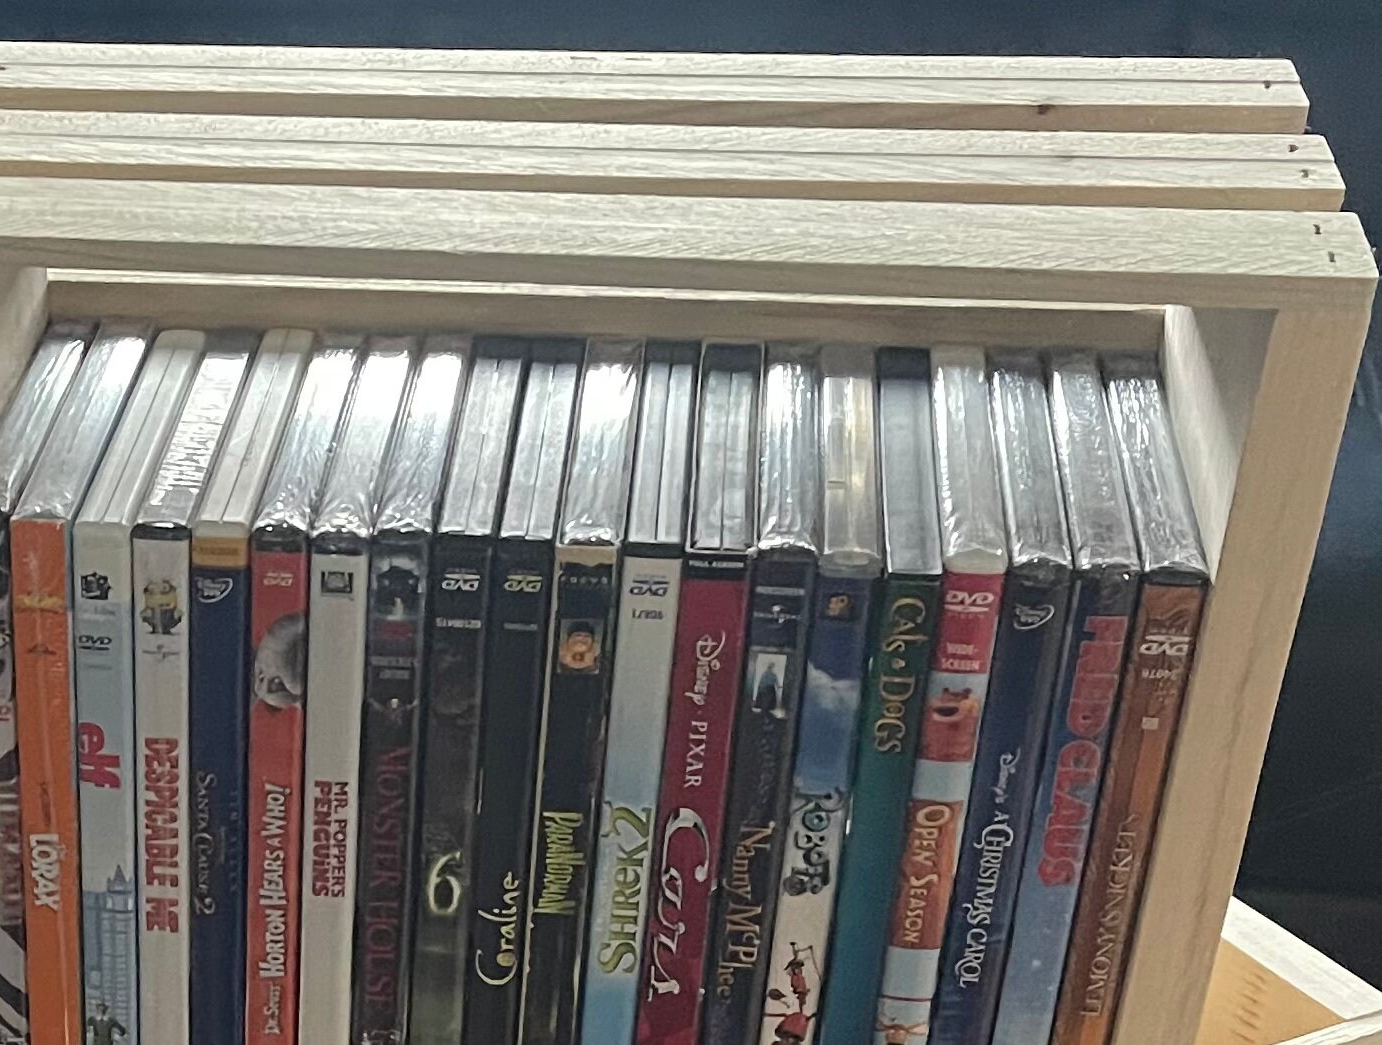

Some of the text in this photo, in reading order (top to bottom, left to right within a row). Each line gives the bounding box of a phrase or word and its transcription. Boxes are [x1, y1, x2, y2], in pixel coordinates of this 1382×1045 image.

[441, 577, 480, 592] DVD
[504, 579, 543, 593] DVD
[629, 584, 669, 598] DVD
[945, 590, 995, 606] DVD
[77, 634, 113, 647] DVD
[1138, 641, 1191, 657] DVD
[874, 672, 916, 754] DOGS
[78, 721, 122, 788] elf
[683, 720, 709, 789] PIXAR
[144, 737, 180, 933] DESPICABLE ME
[260, 782, 292, 837] WHO!
[311, 780, 333, 897] PENGUINS
[369, 745, 412, 887] MONSTER
[608, 804, 654, 839] 2
[1037, 739, 1101, 888] CLAUS
[28, 832, 62, 914] LORAX
[194, 896, 216, 916] 2
[258, 849, 288, 905] HEARS
[902, 803, 952, 944] OPEN SEASON
[961, 822, 1014, 927] CHRISTMAS
[258, 908, 286, 977] HORTON
[475, 870, 521, 986] Coraline
[715, 819, 776, 1001] Nanny McPhee
[954, 927, 989, 990] CAROL
[1079, 926, 1117, 1017] LEMONY
